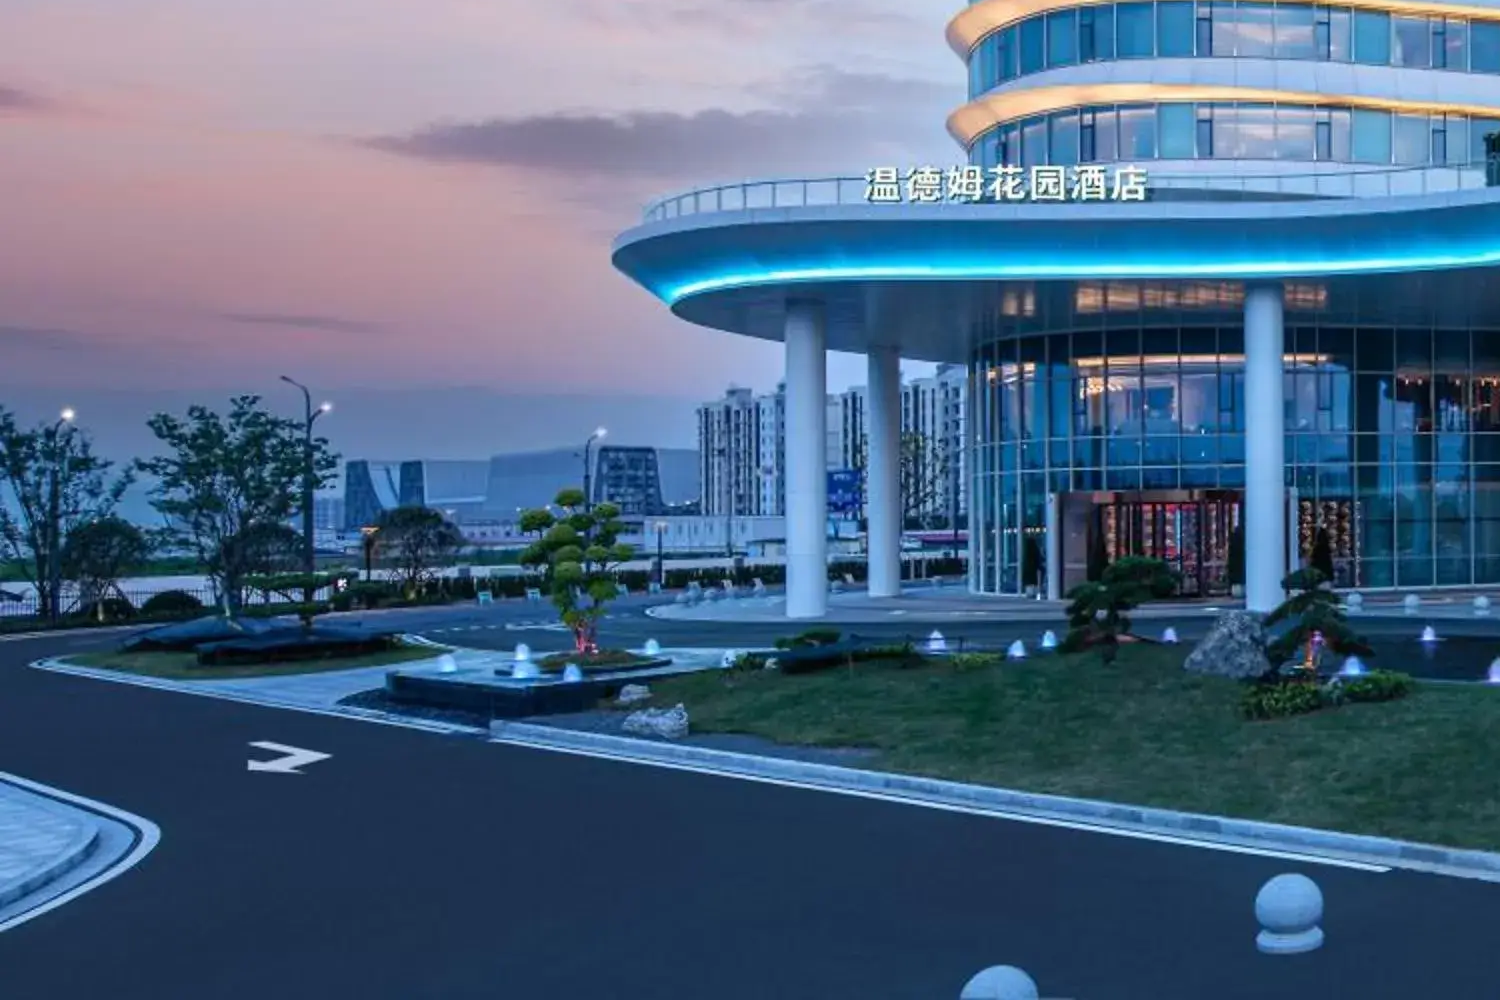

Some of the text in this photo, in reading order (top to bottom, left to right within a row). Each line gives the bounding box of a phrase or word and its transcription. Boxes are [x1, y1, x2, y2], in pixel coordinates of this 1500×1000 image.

[863, 164, 1148, 201] 温德姆花园酒店
